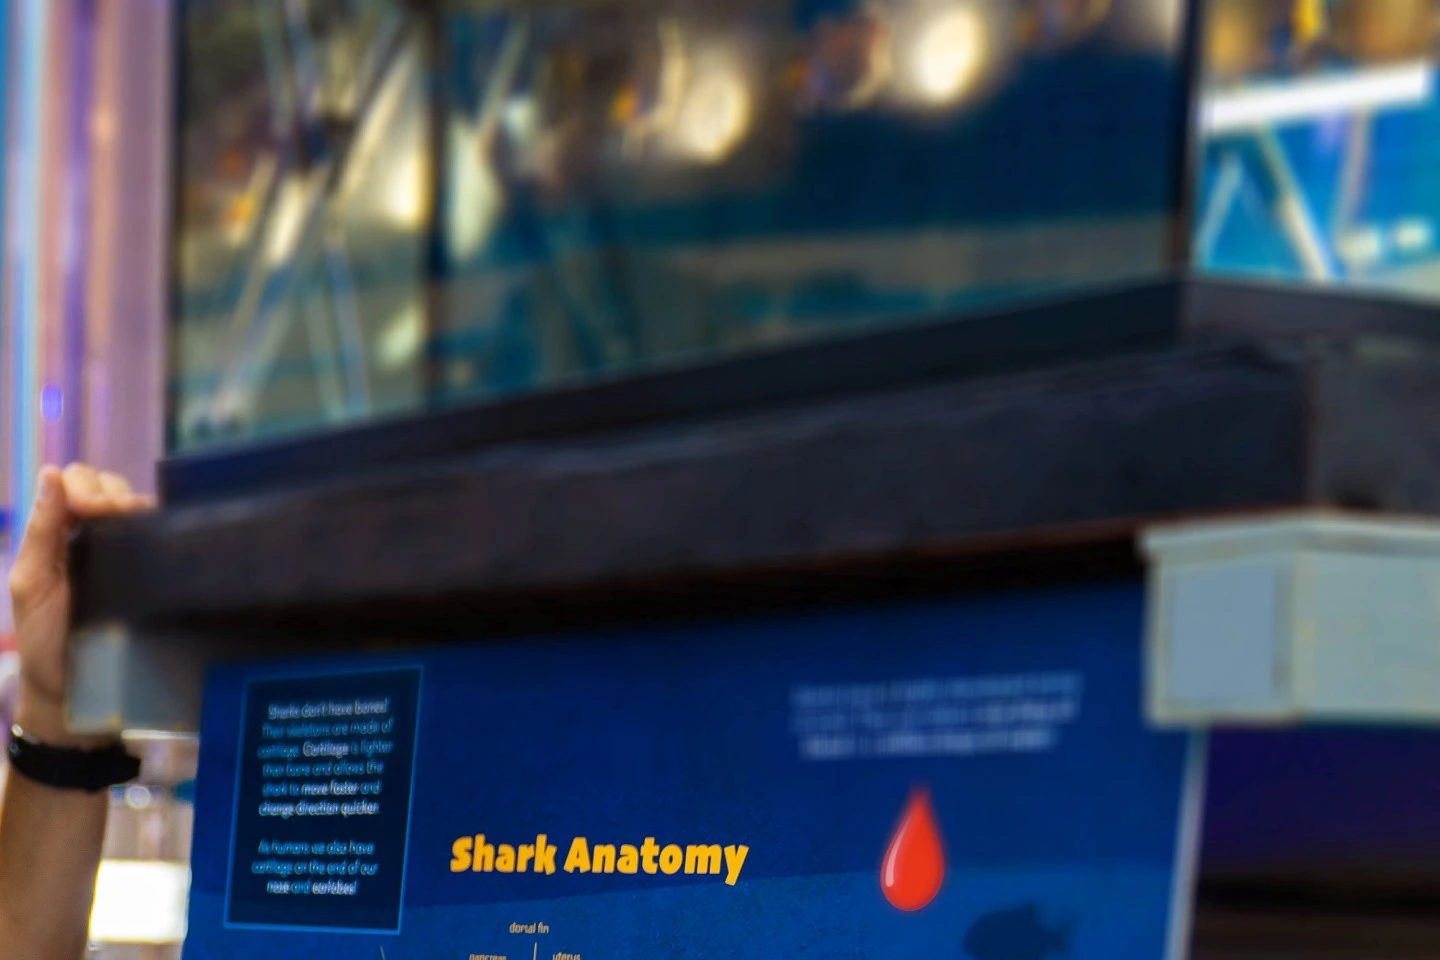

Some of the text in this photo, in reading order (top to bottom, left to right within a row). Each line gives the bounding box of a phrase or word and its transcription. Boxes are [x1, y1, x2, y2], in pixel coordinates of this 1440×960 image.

[328, 701, 353, 716] have
[303, 741, 350, 759] Cartilage
[302, 783, 329, 795] move
[259, 800, 295, 818] change
[296, 799, 339, 816] direction
[450, 833, 749, 886] Shark Anatomy
[267, 880, 290, 894] nose
[509, 922, 549, 933] dorsal fin
